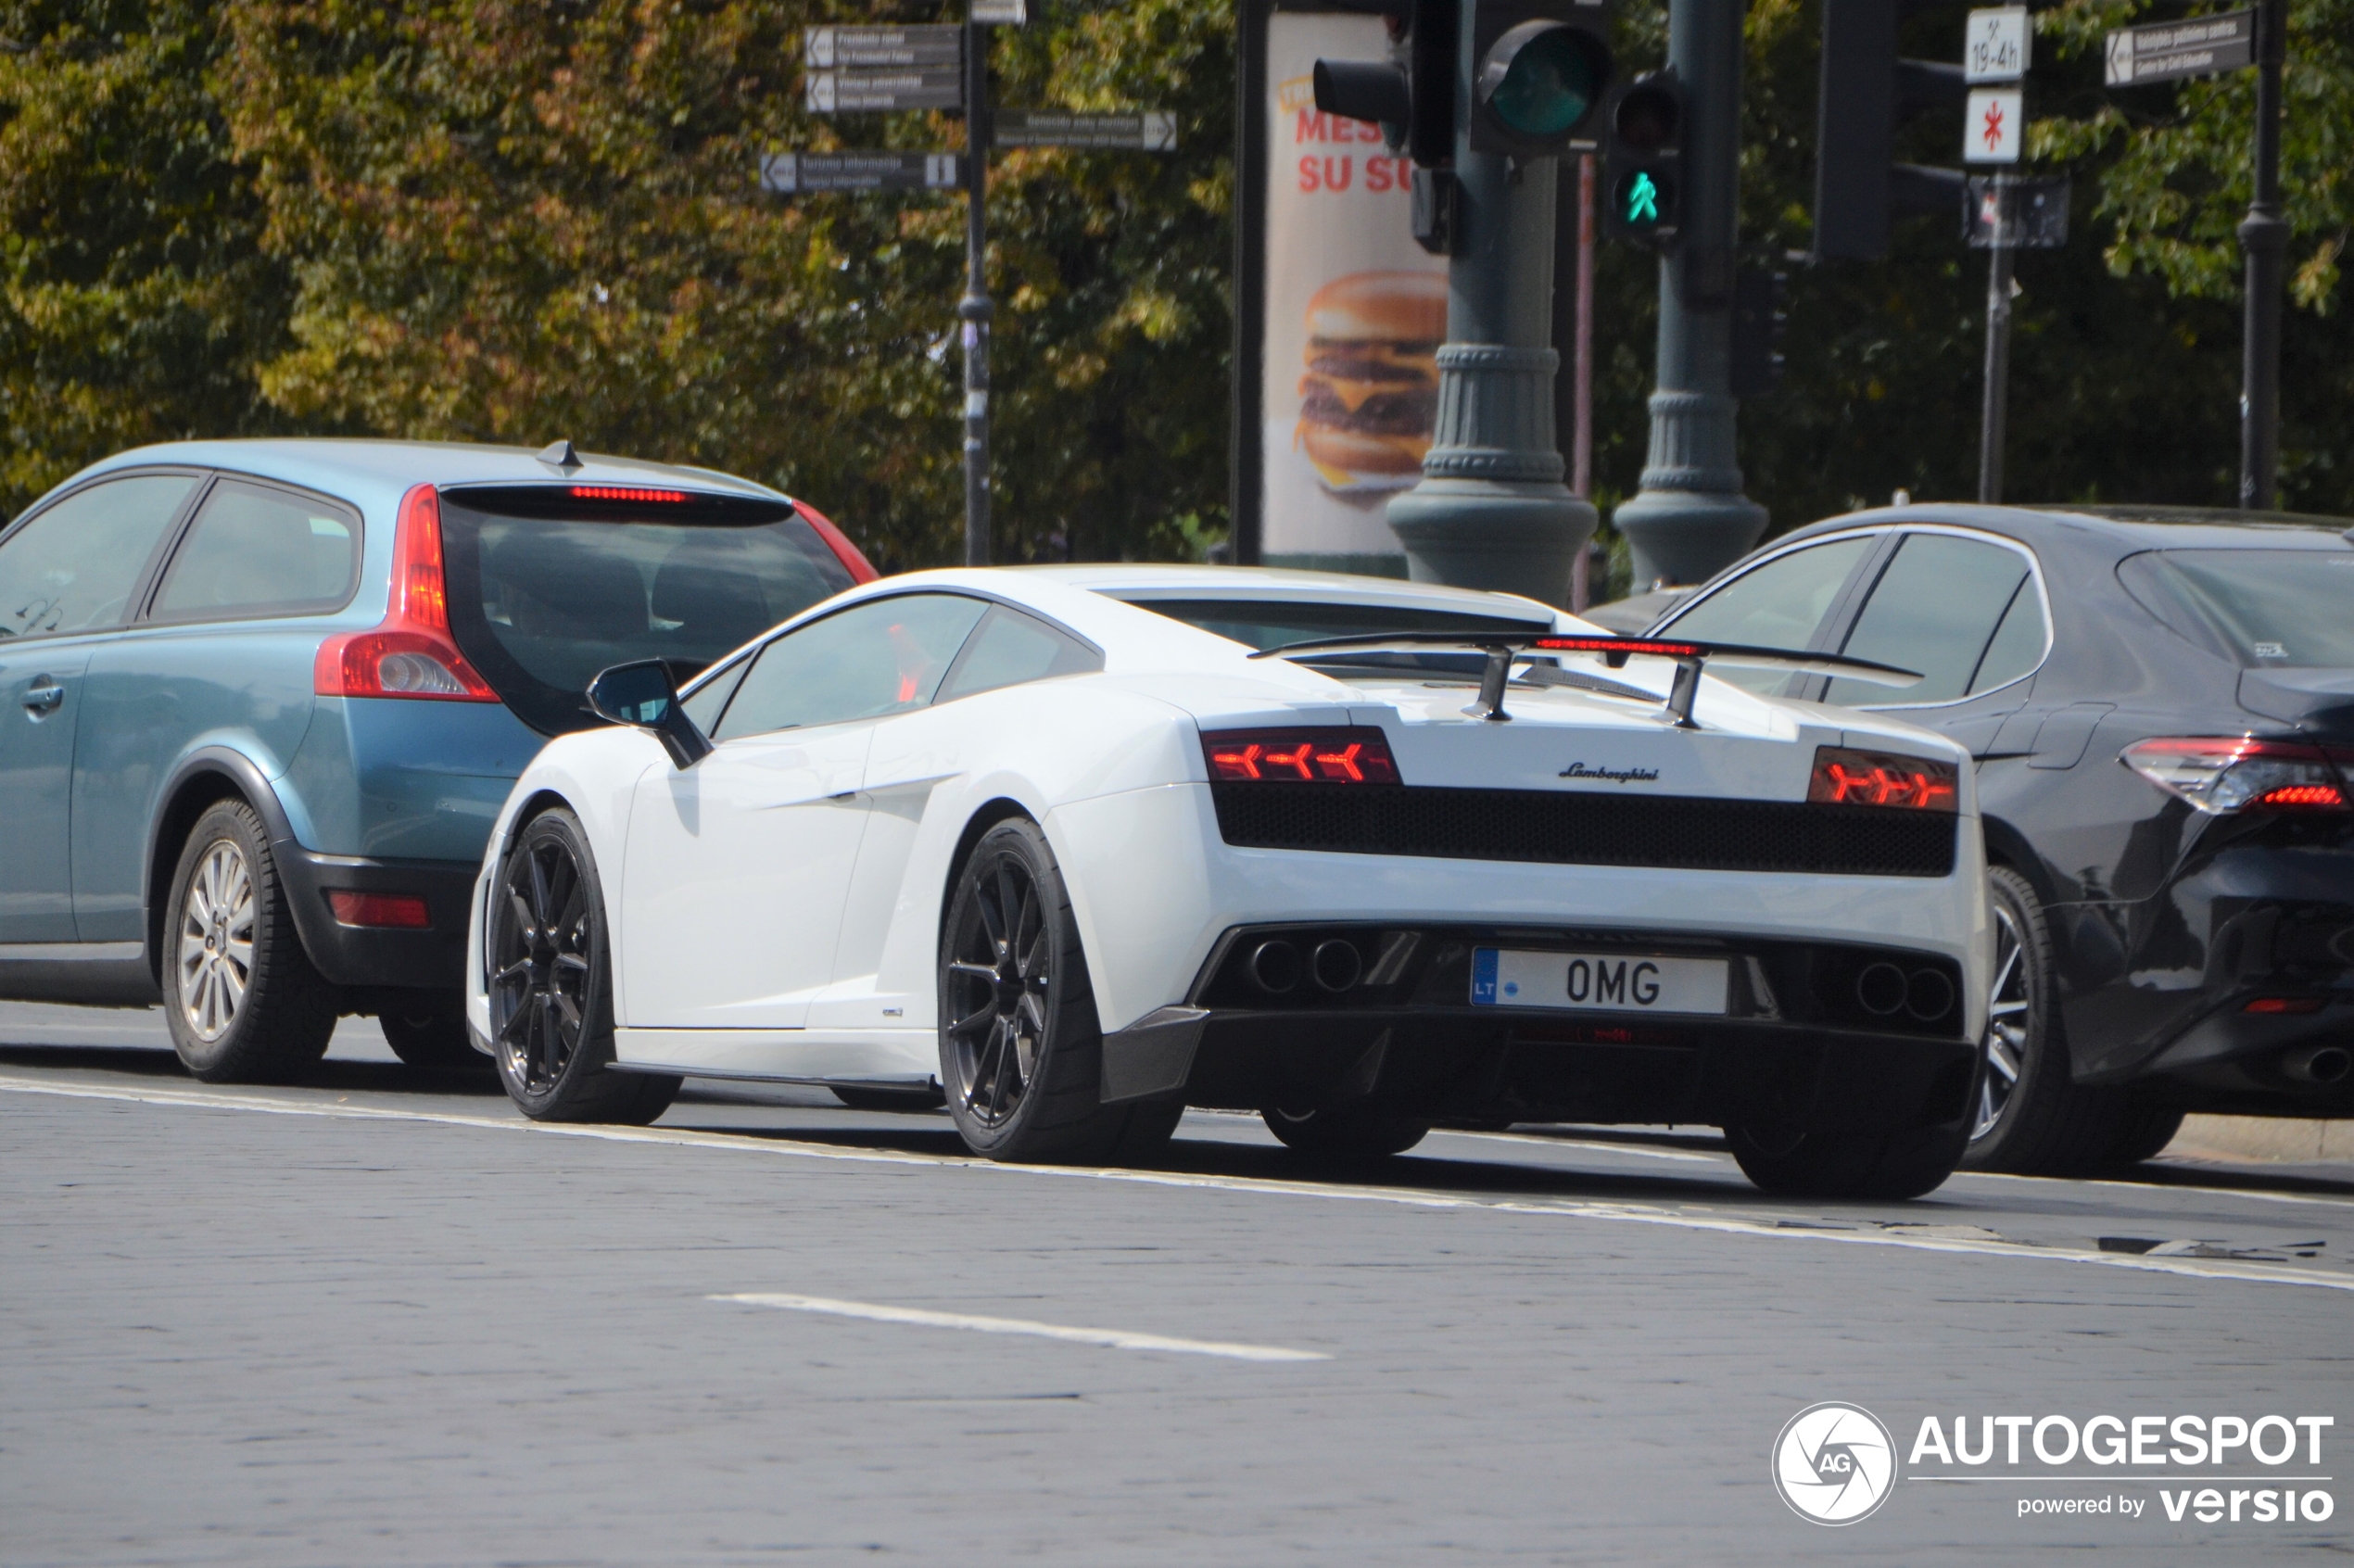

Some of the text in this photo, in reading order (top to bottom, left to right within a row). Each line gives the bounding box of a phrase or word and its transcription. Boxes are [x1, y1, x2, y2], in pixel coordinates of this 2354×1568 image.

[1972, 40, 2018, 72] 19-4h
[1298, 154, 1353, 193] SU
[1559, 762, 1660, 783] Lamborghini
[1475, 982, 1494, 995] LT
[1567, 958, 1661, 1005] OMG
